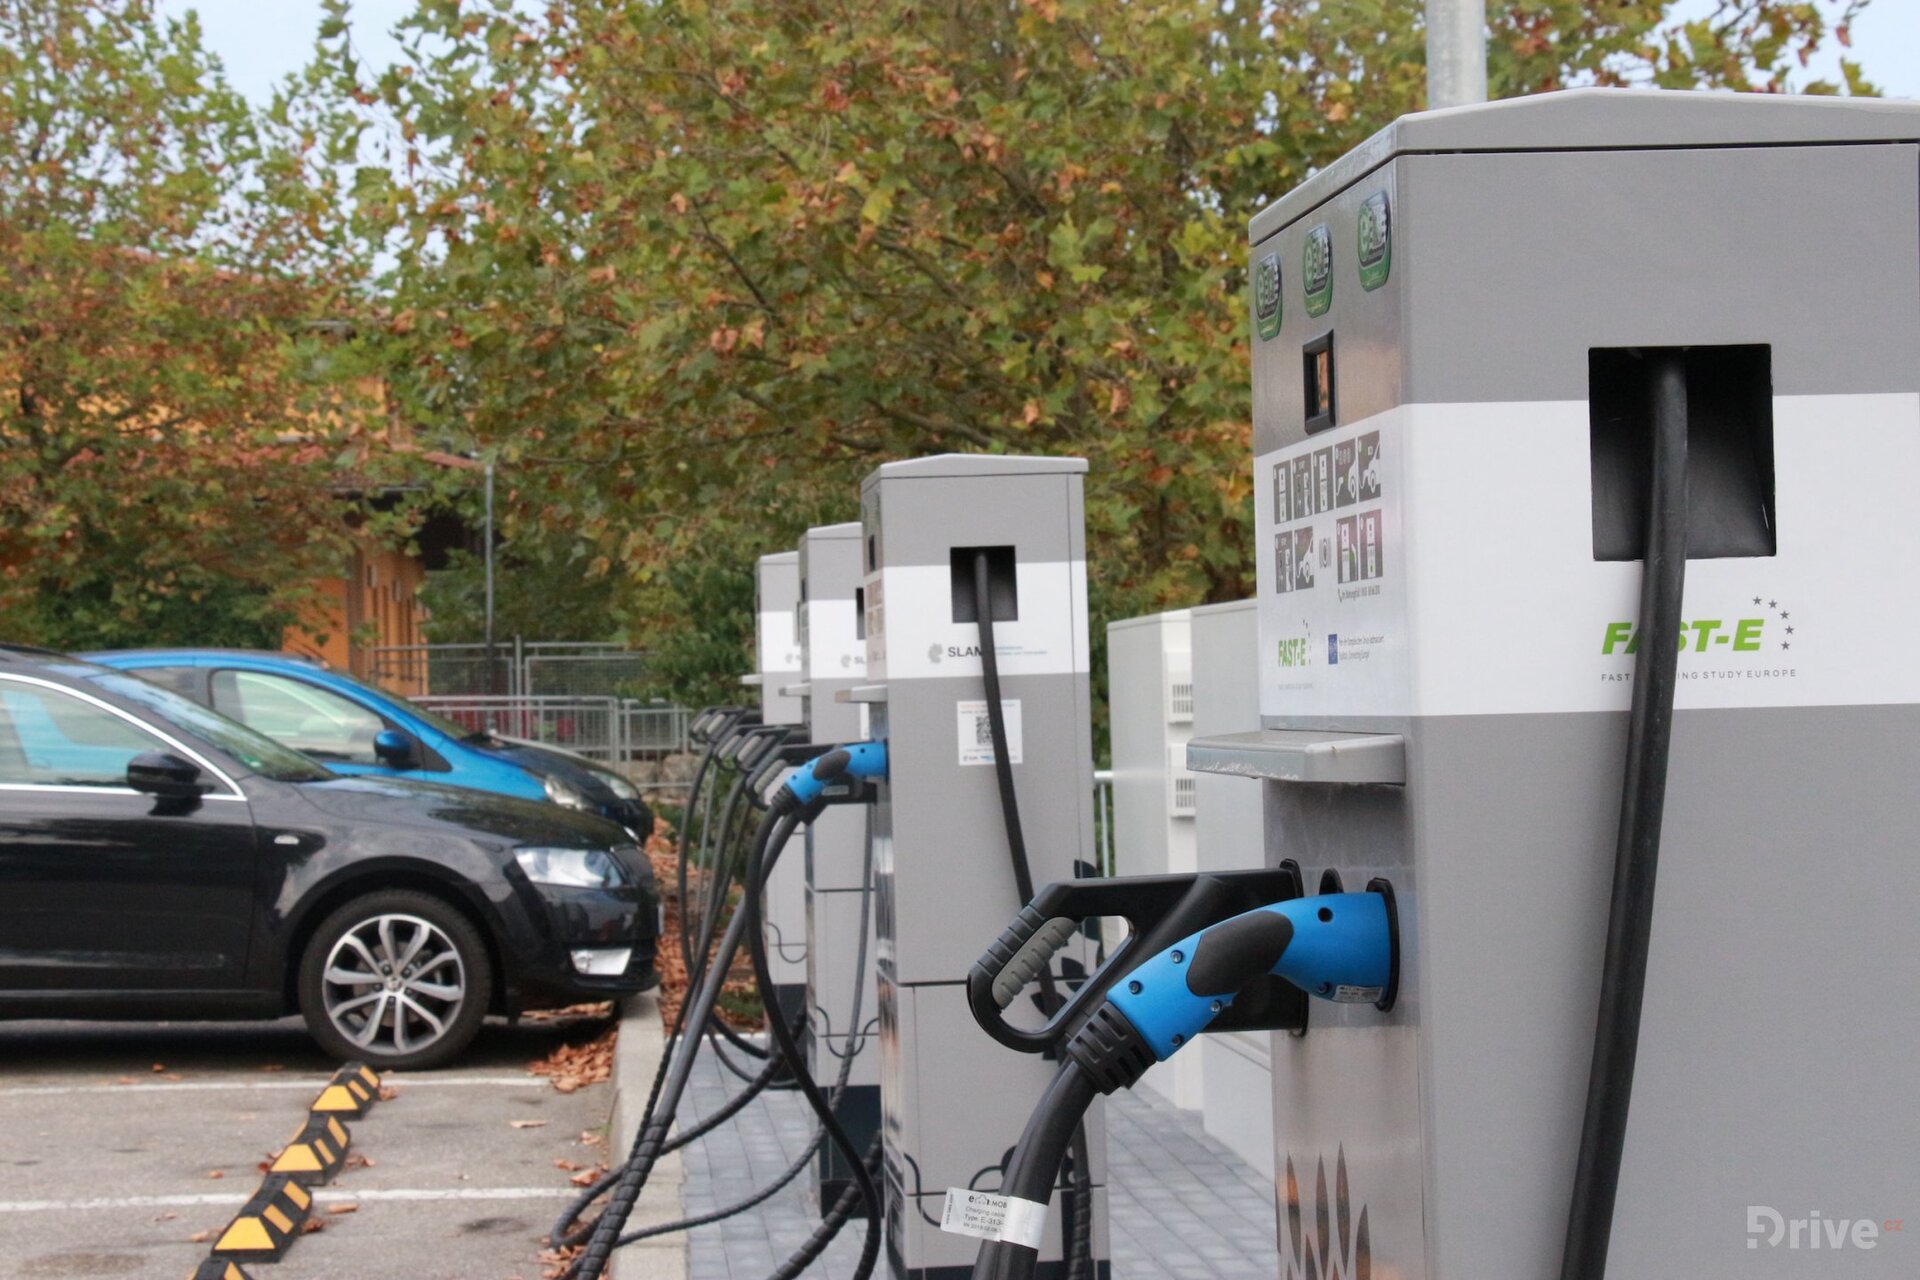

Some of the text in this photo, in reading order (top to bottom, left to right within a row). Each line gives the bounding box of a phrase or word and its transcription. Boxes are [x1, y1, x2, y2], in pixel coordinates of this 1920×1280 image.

[1278, 637, 1306, 667] FAST-E
[1601, 673, 1631, 682] FAST
[1702, 670, 1742, 680] STUDY
[1747, 668, 1797, 679] EUROPE
